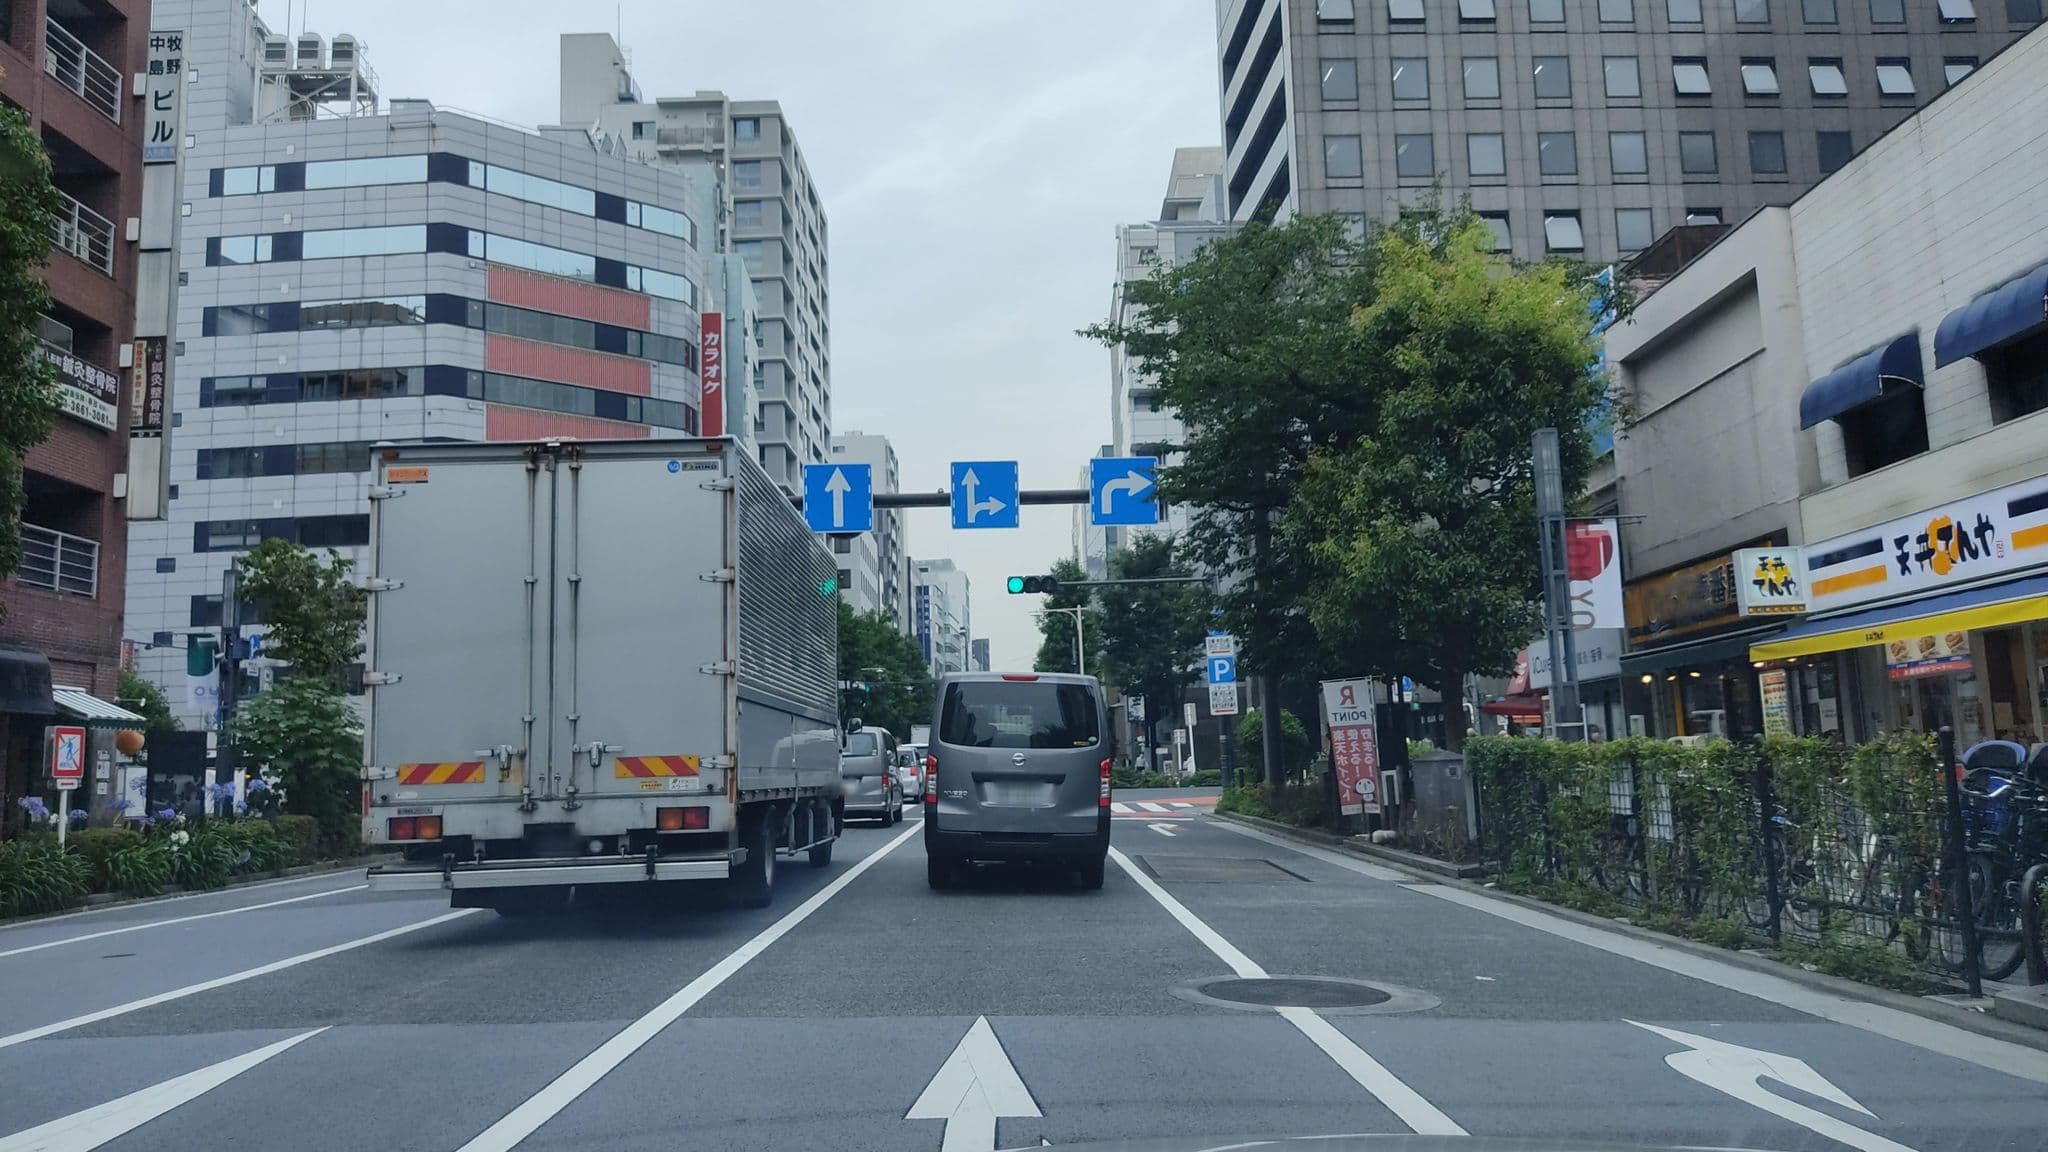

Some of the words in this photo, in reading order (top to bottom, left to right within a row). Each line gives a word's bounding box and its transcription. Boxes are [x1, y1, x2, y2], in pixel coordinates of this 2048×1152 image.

[149, 36, 165, 75] 中島
[166, 36, 182, 75] 牧野
[152, 89, 175, 142] ビル
[704, 332, 720, 394] カラオケ
[1752, 576, 1797, 598] てんや
[1214, 659, 1231, 682] P
